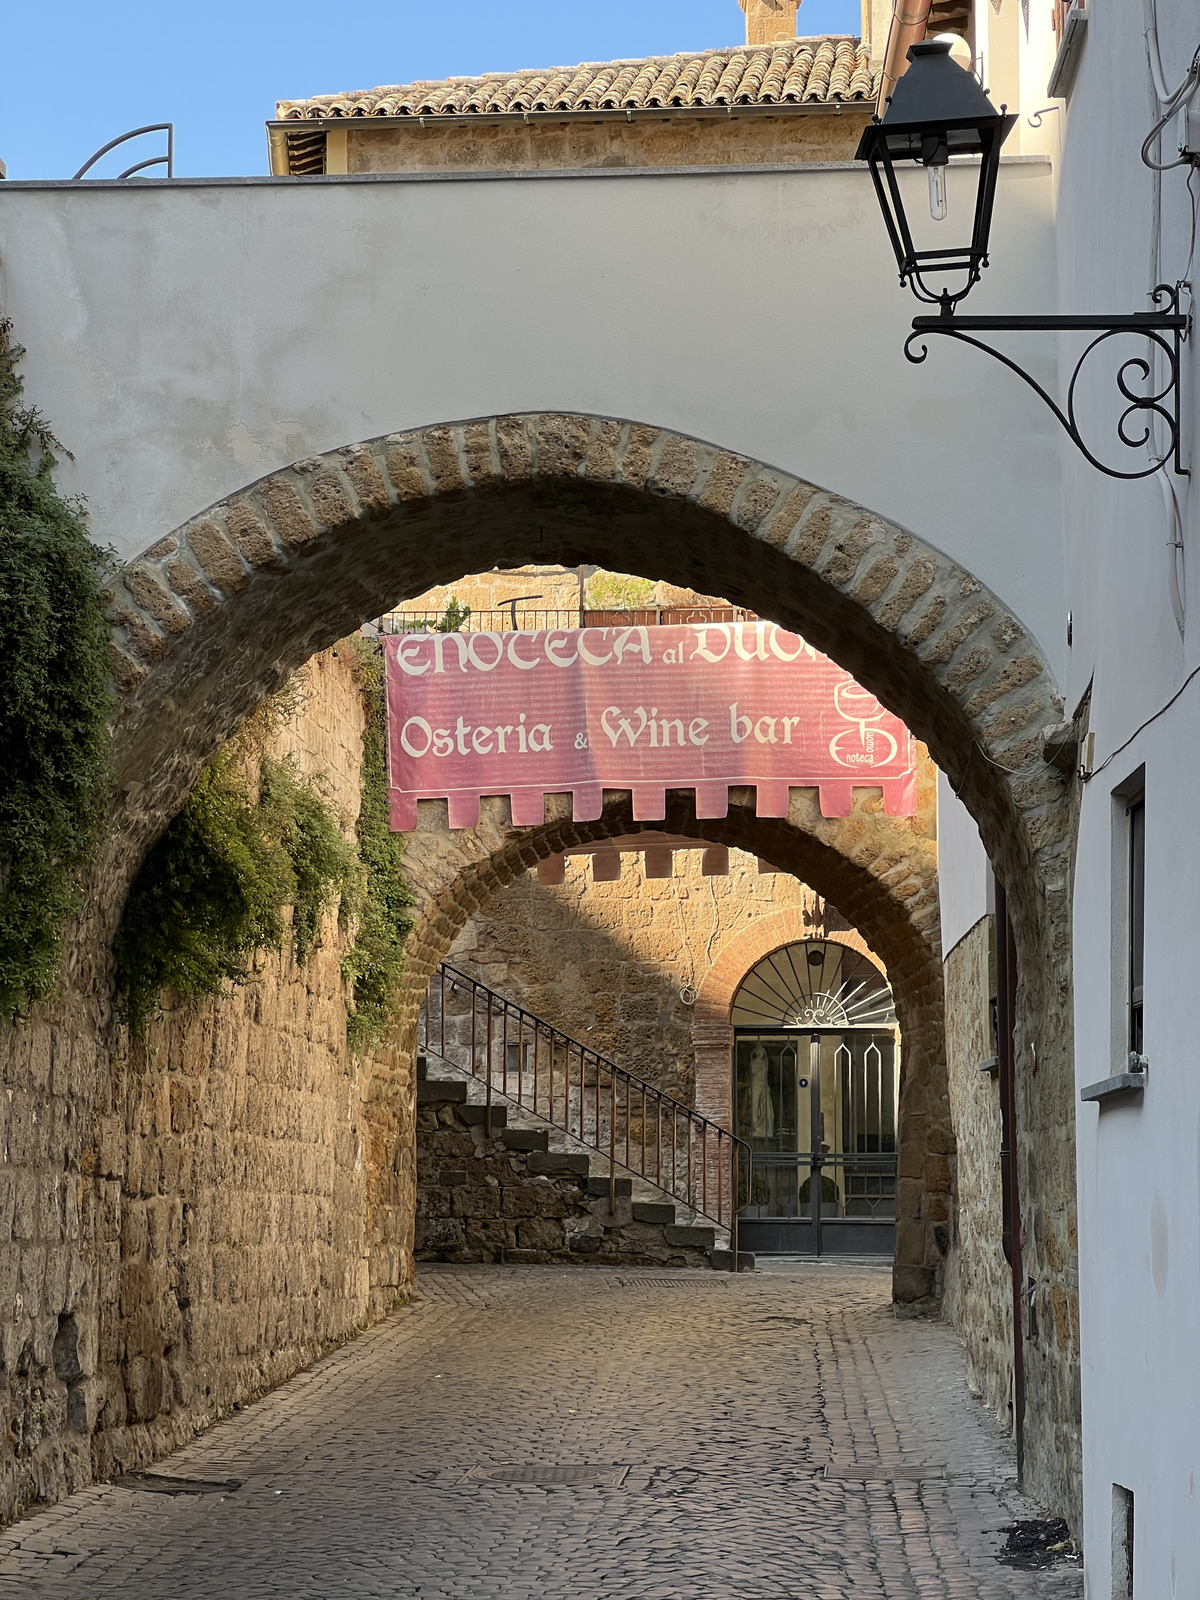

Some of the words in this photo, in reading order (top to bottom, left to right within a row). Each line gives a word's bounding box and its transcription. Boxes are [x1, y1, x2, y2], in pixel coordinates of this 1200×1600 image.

[662, 641, 684, 665] al
[689, 622, 817, 663] DUO
[400, 712, 554, 758] Osteria
[573, 732, 588, 750] &
[600, 705, 710, 748] Wine
[728, 701, 801, 745] bar
